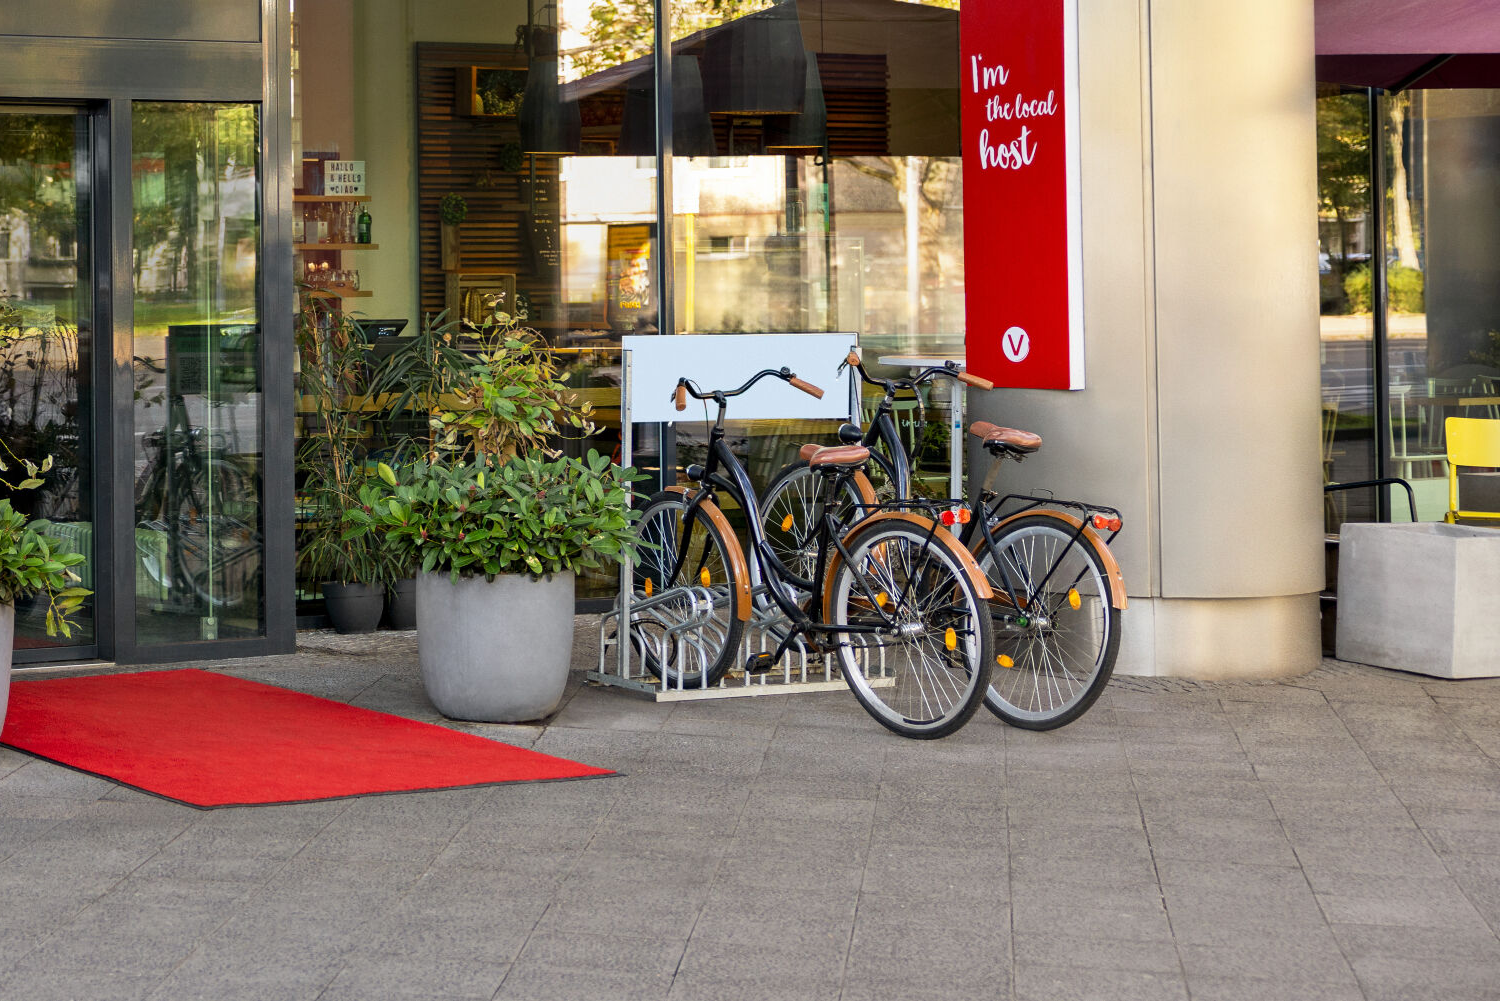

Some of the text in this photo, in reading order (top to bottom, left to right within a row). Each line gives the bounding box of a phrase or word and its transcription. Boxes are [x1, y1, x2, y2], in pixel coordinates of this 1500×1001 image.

[971, 53, 1009, 93] I'm
[985, 90, 1057, 122] the local
[979, 125, 1038, 170] host
[330, 162, 354, 172] HALLO
[338, 174, 362, 183] HELLO
[1007, 334, 1024, 356] V
